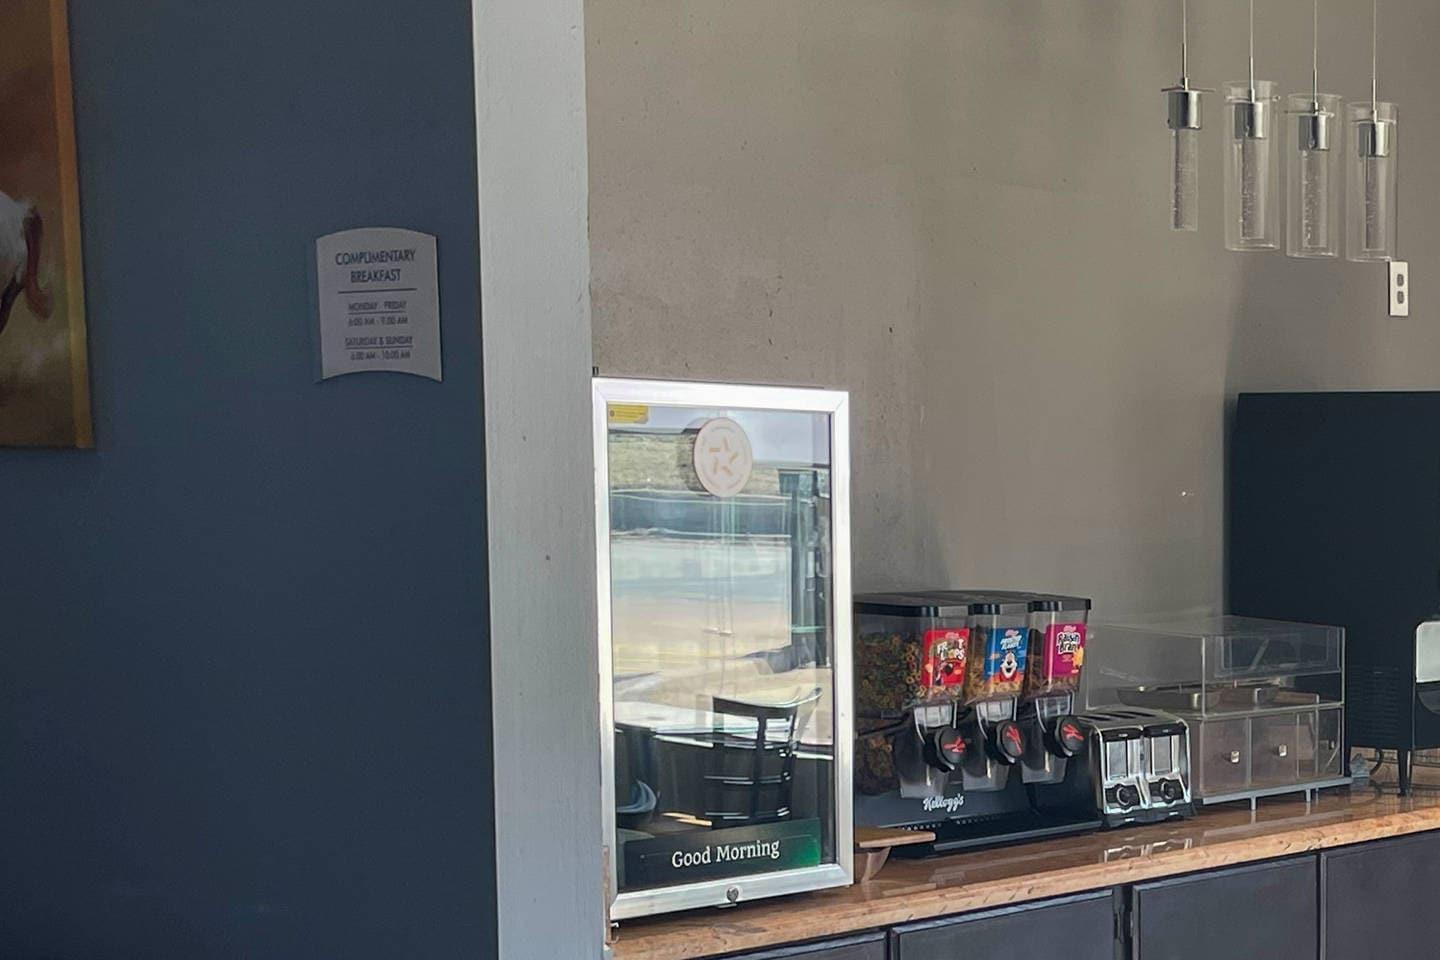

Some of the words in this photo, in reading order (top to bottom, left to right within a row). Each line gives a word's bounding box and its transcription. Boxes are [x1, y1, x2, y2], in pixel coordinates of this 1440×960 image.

[335, 248, 416, 266] COMPLIMENTARY
[350, 268, 401, 283] BREAKFAST
[348, 302, 378, 311] MONDAY
[384, 301, 407, 310] FRIDAY
[937, 638, 964, 655] FRT
[923, 792, 965, 813] Kellogg's
[671, 846, 711, 868] Good
[716, 839, 780, 860] Morning
